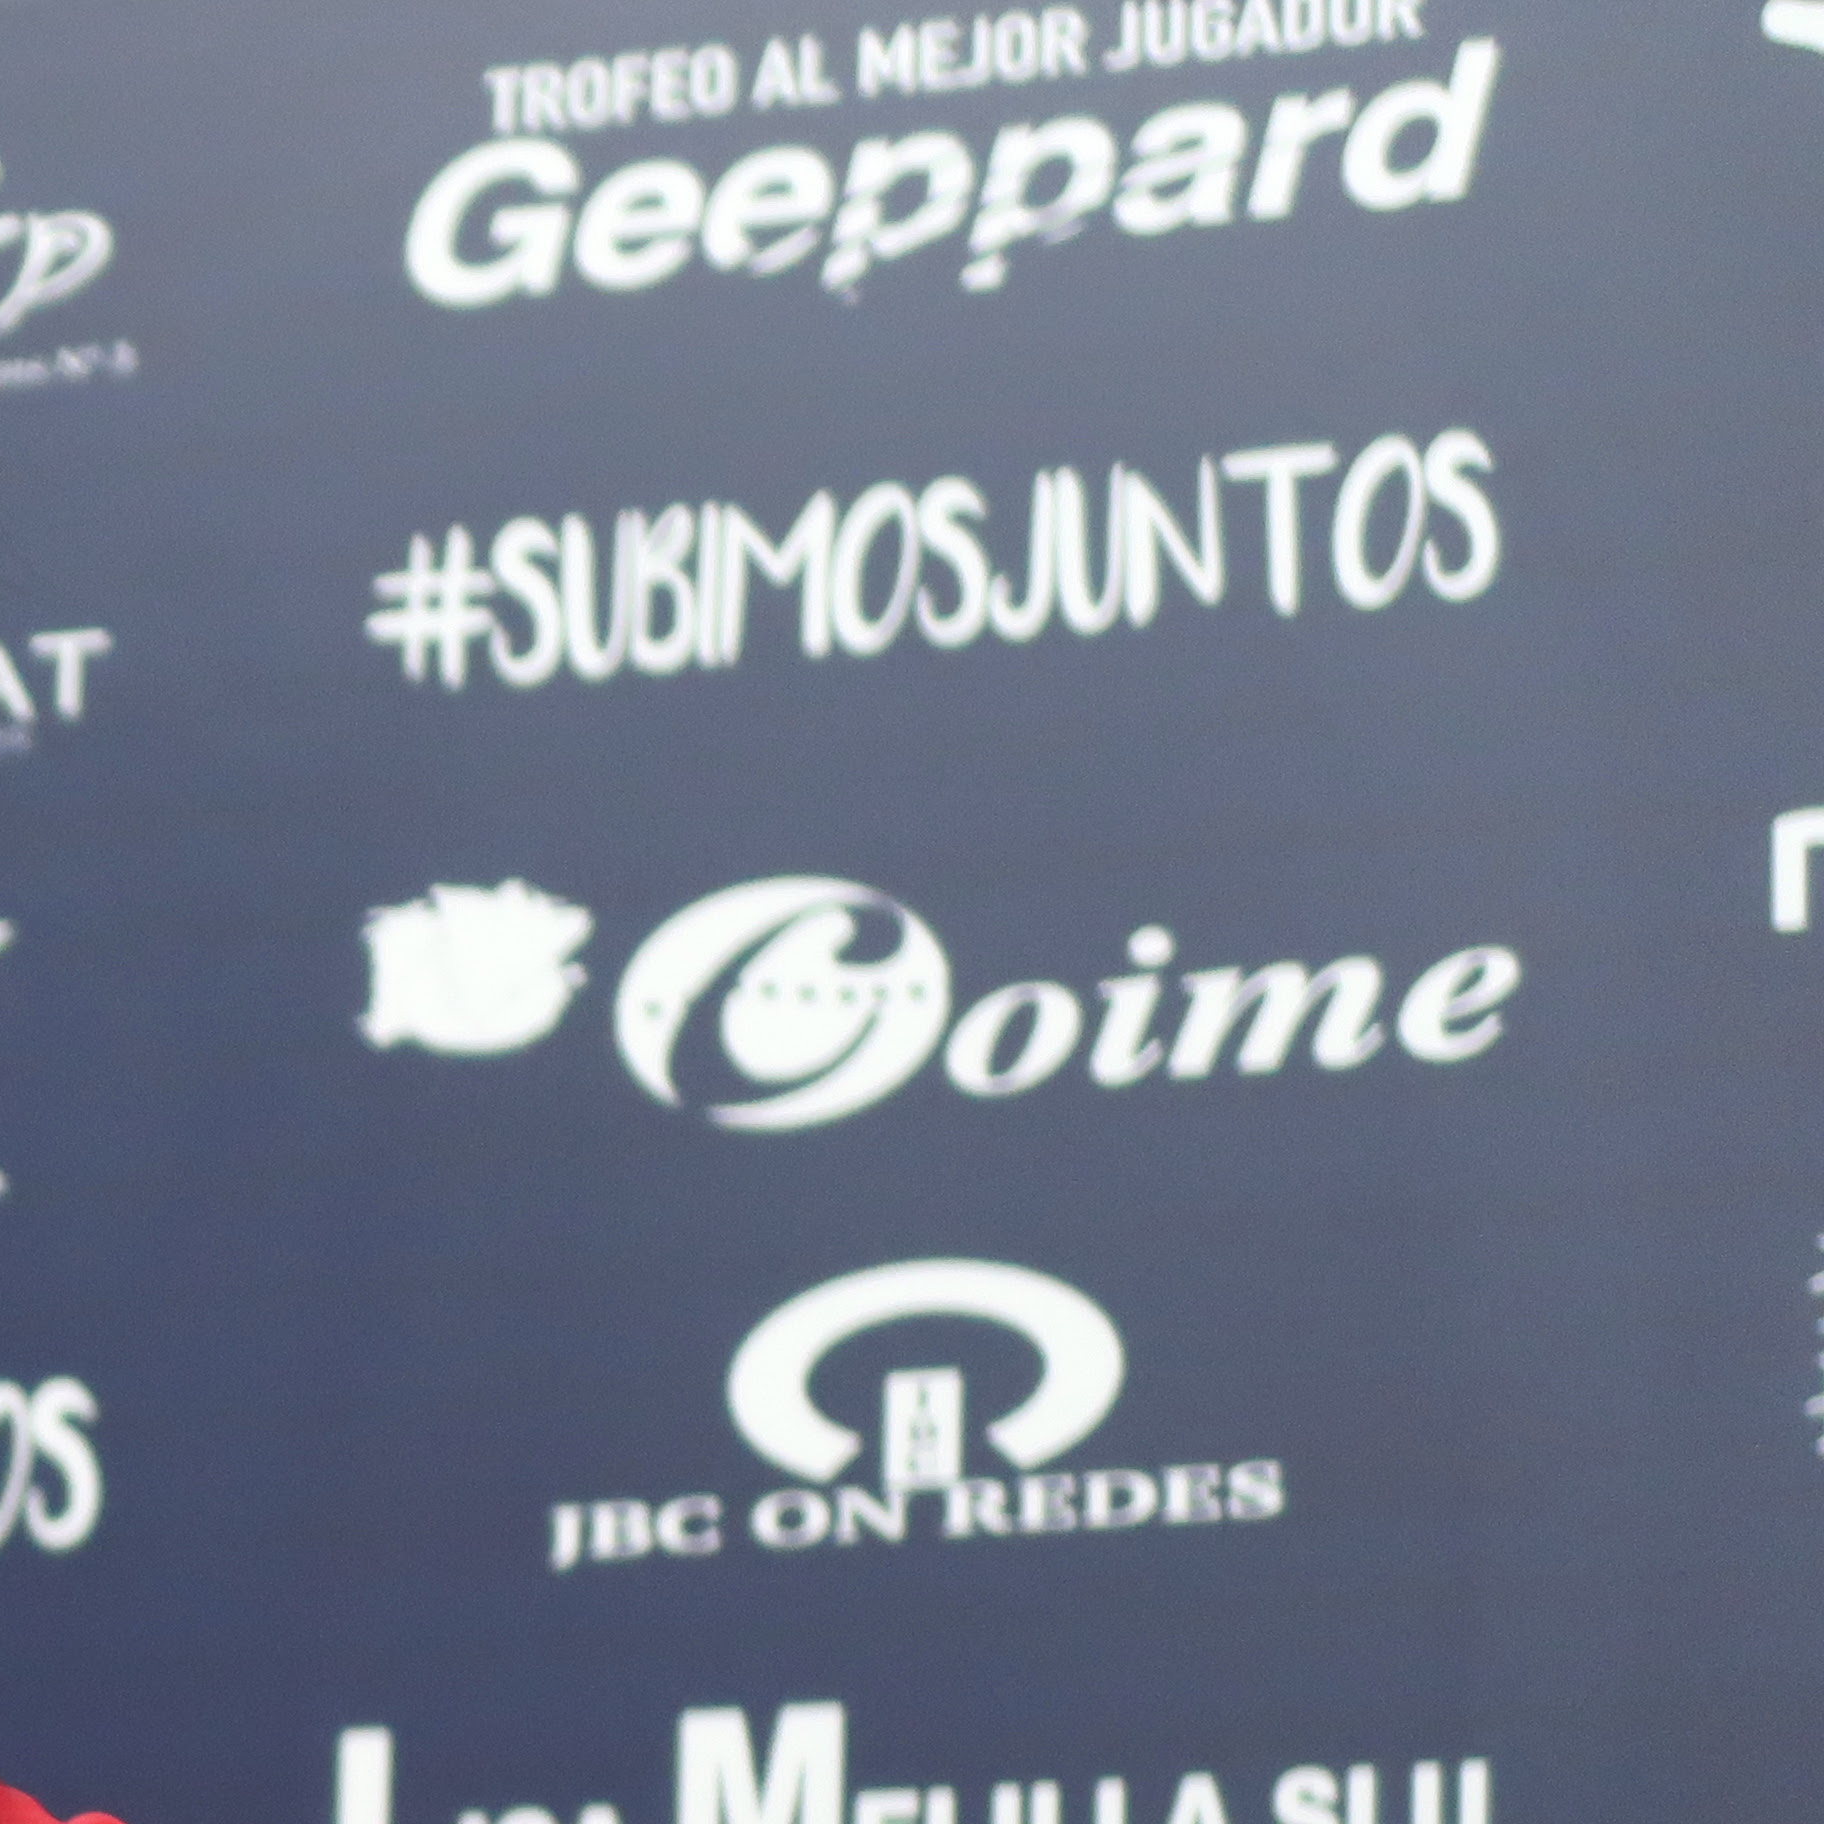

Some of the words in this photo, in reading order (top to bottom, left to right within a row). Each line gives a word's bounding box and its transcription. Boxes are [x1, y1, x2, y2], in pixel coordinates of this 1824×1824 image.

[485, 44, 736, 136] TROFEO
[751, 34, 837, 106] AL
[857, 3, 1090, 97] MEJOR
[1104, 0, 1426, 72] JUGADOR
[404, 36, 1500, 310] Geeppard
[363, 426, 1504, 692] #SUBIMOSJUNTOS
[550, 1496, 723, 1570] JBC
[752, 1480, 908, 1550] ON
[944, 1460, 1288, 1542] REDES
